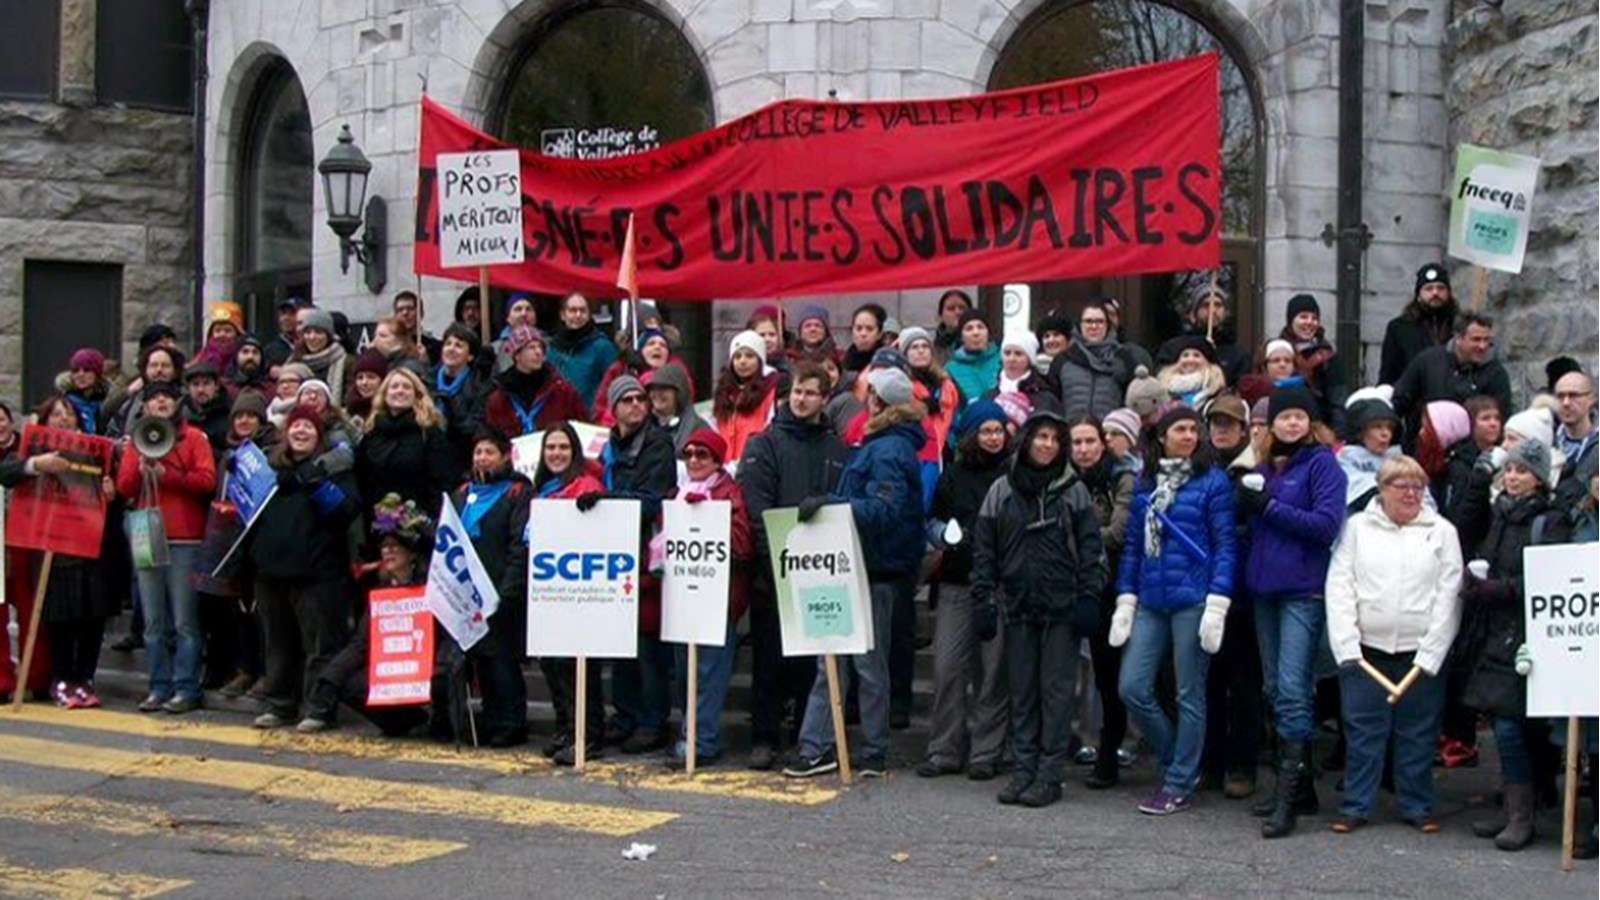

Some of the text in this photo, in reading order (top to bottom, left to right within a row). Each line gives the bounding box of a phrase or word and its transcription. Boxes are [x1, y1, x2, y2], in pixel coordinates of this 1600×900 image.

[833, 102, 865, 132] DE
[877, 81, 1099, 132] VALLEYFIELD
[577, 125, 658, 146] Collège de
[445, 170, 518, 198] PROFS
[1458, 177, 1514, 210] fneeq
[666, 540, 727, 563] PROFS
[779, 548, 835, 579] fneeq
[532, 552, 635, 581] SCFP
[674, 563, 716, 578] EN NÉGO
[1547, 624, 1565, 638] EN
